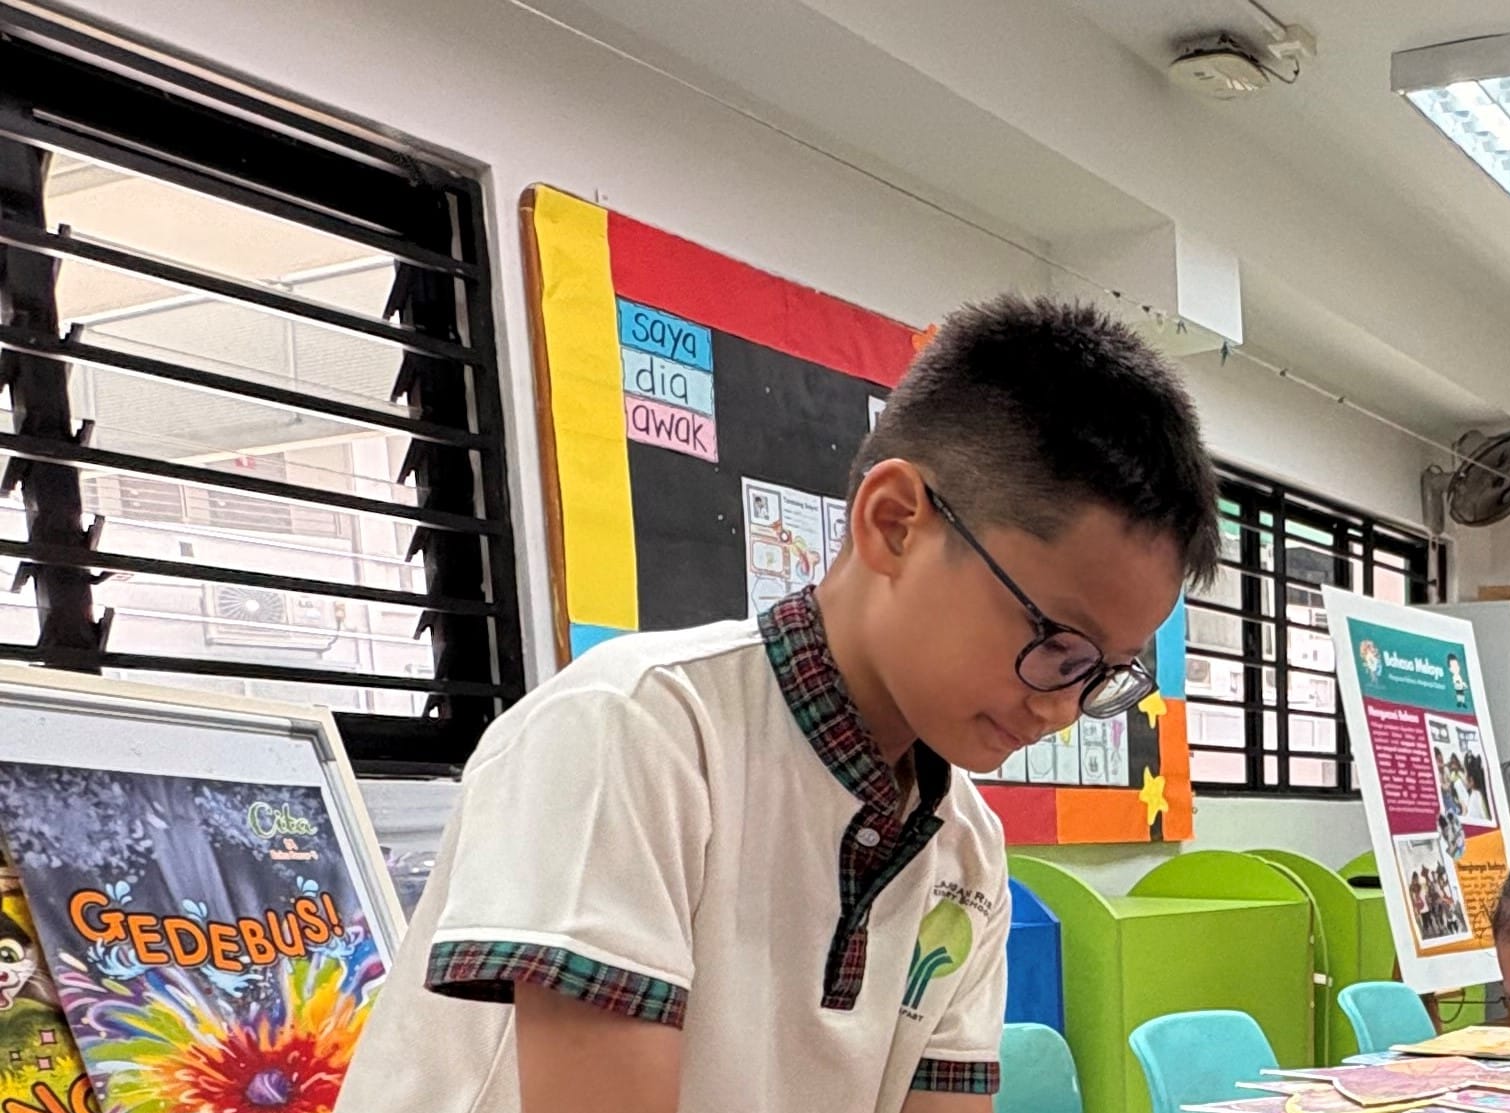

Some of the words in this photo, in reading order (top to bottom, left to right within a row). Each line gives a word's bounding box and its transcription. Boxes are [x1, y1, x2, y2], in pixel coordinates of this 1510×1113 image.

[632, 312, 697, 361] saya
[635, 356, 689, 405] dia
[632, 404, 708, 453] awak
[247, 801, 318, 839] Cita
[68, 889, 345, 973] GEDEBUS!
